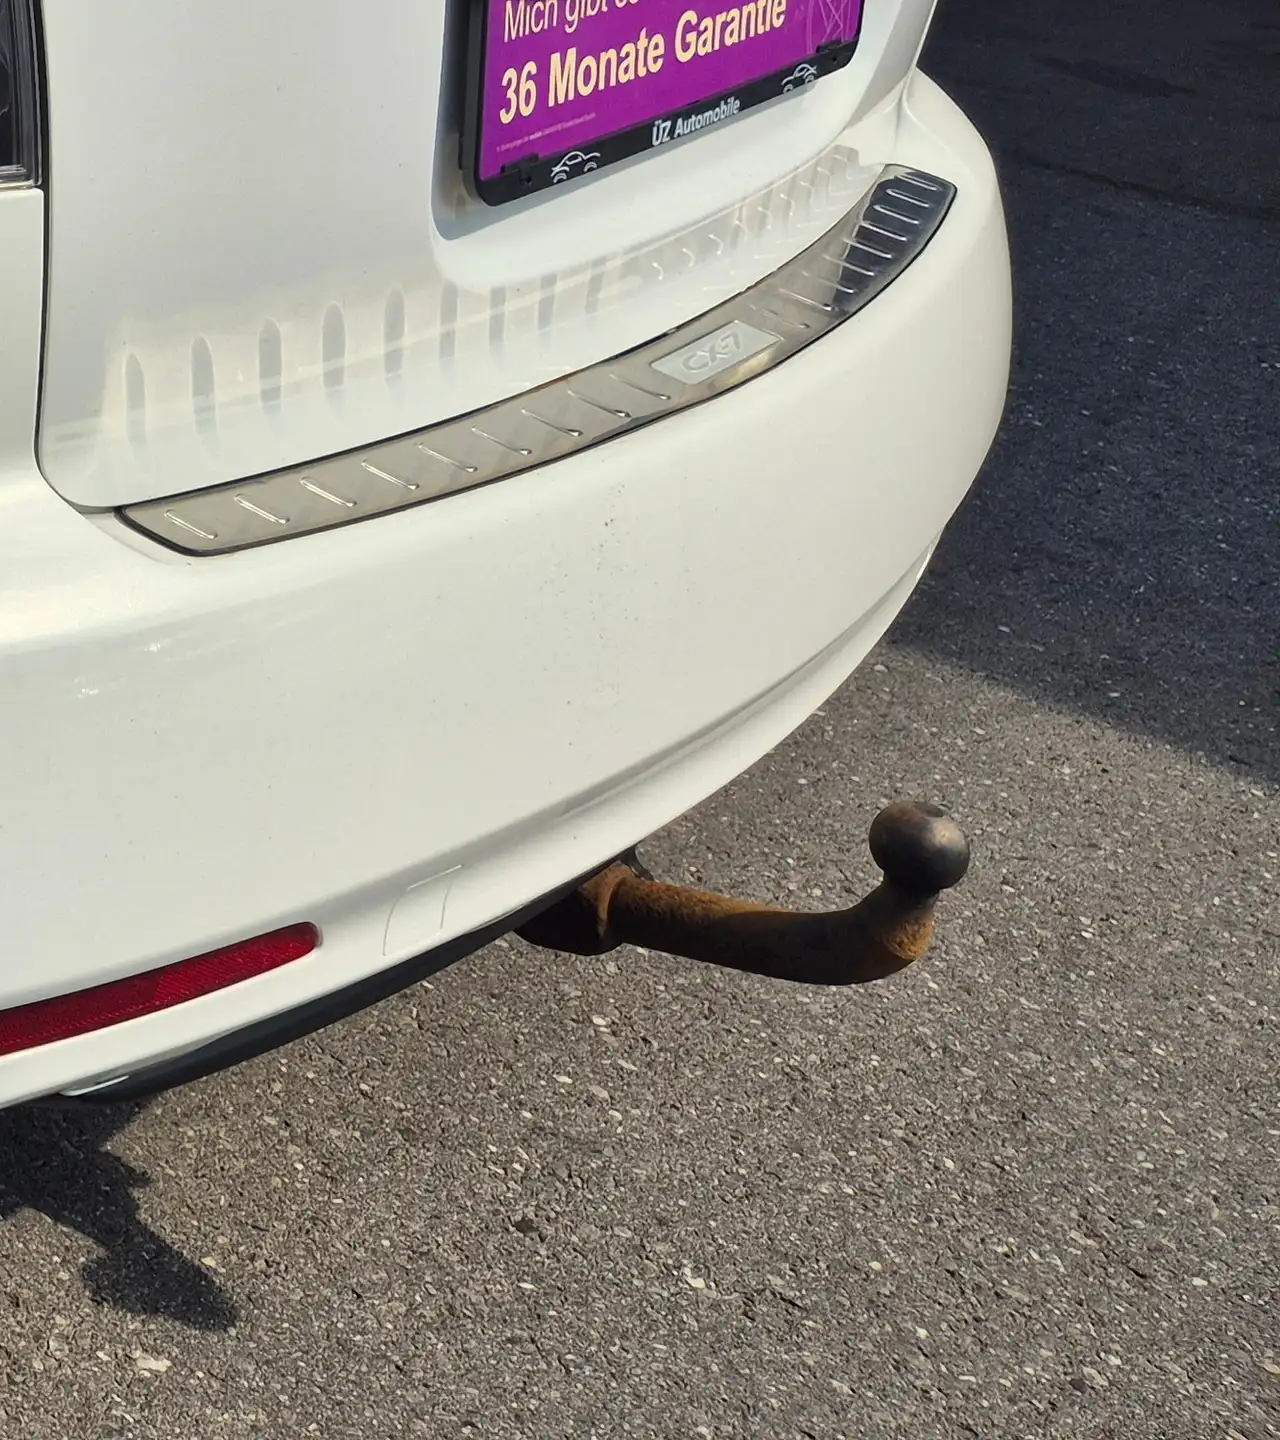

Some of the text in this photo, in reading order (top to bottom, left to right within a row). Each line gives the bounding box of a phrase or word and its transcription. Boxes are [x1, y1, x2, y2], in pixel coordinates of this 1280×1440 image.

[499, 62, 537, 124] 36
[548, 23, 664, 108] Monate
[651, 98, 740, 146] ÜZ Automobile
[681, 329, 741, 373] CX-7
